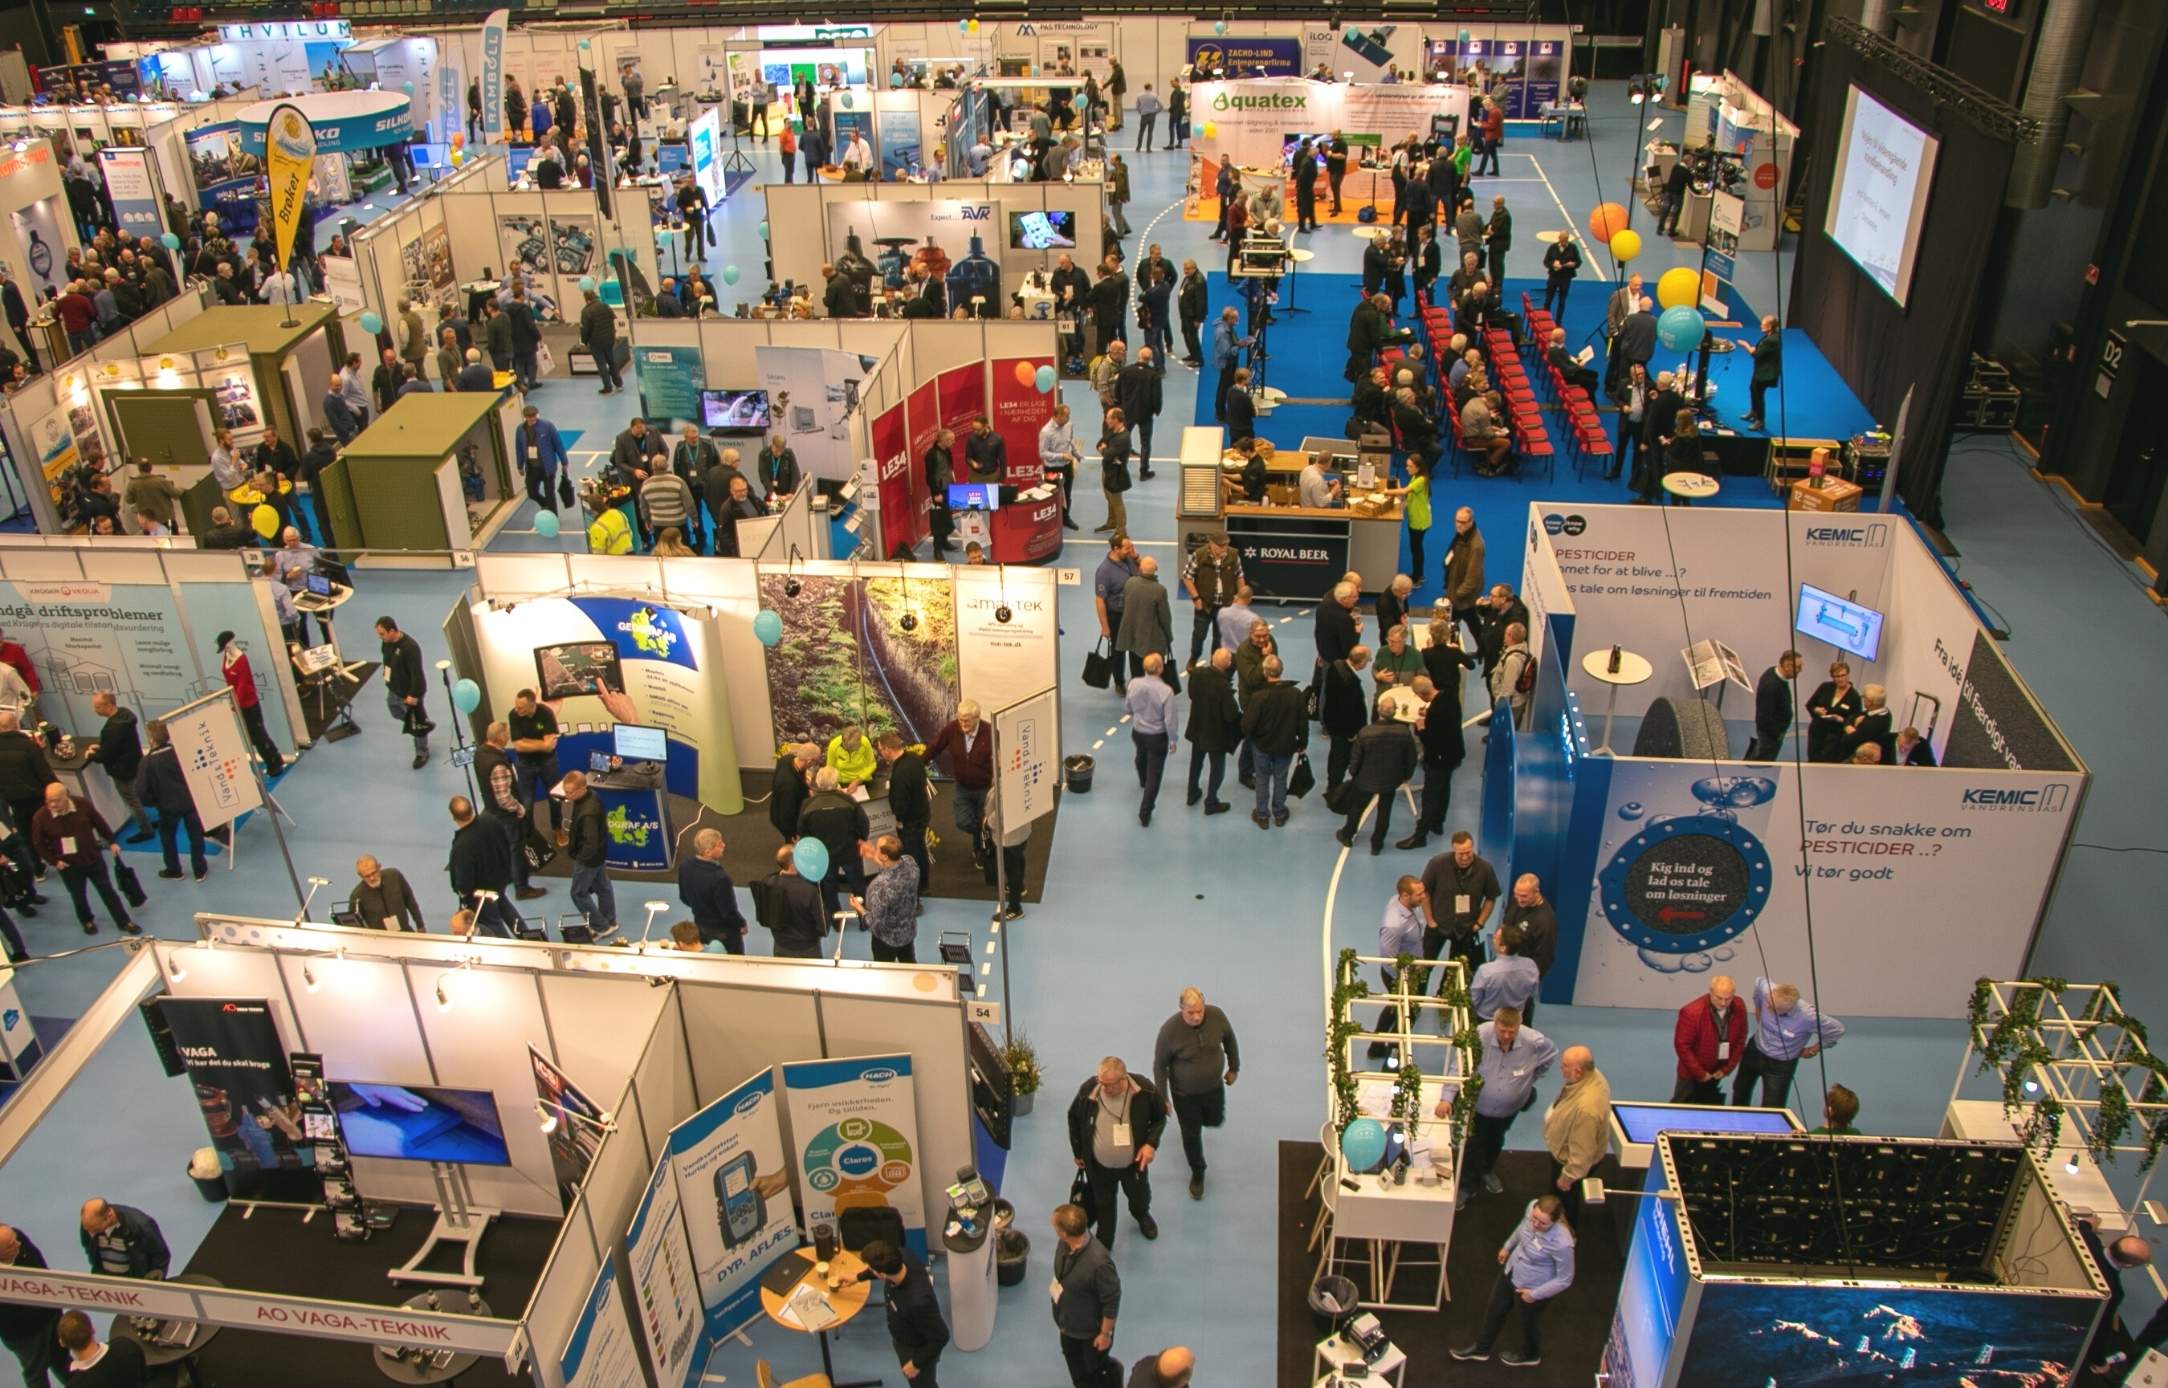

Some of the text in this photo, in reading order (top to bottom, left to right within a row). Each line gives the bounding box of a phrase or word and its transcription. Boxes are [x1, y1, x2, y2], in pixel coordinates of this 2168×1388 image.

[221, 22, 351, 39] THVILUM
[1228, 49, 1274, 57] ZACHO-LIND
[961, 206, 990, 220] AVK
[2104, 340, 2122, 368] D2
[883, 450, 908, 481] LE34
[1006, 464, 1043, 479] LE34
[1033, 504, 1057, 522] LE34
[1806, 528, 1865, 541] KEMIC
[1260, 547, 1329, 560] ROYAL BEER
[1556, 549, 1636, 562] PESTICIDER
[1593, 564, 1613, 575] for
[1615, 566, 1629, 576] at
[1631, 566, 1663, 578] blive
[1580, 584, 1605, 594] tale
[1607, 587, 1628, 595] om
[1631, 585, 1691, 598] løsninger
[1694, 585, 1707, 598] til
[1708, 585, 1772, 600] fremtiden
[39, 605, 164, 621] driftsproblemer
[1934, 637, 1948, 666] Fra
[1963, 678, 1975, 703] til
[1971, 692, 2006, 754] færdigt
[1022, 724, 1031, 757] Vand
[216, 772, 233, 802] Vand
[1962, 789, 2040, 805] KEMIC
[1961, 804, 2035, 812] VANDRENS
[1805, 820, 1972, 838] Tør du snakke om
[1799, 839, 1915, 856] PESTICIDER
[1651, 862, 1713, 875] Kig ind og
[1794, 864, 1895, 882] Vi tør godt
[1648, 876, 1711, 888] lad os tale
[1645, 890, 1729, 902] om løsninger
[975, 1008, 990, 1018] 54
[180, 1046, 218, 1057] VAGA
[864, 1072, 893, 1080] HACH
[737, 1092, 762, 1111] HACH
[843, 1157, 873, 1165] Claros
[716, 1225, 795, 1282] DYP. AFLÆS.
[0, 1278, 144, 1307] VAGA-TEKNIK
[257, 1306, 452, 1341] AO VAGA-TEKNIK
